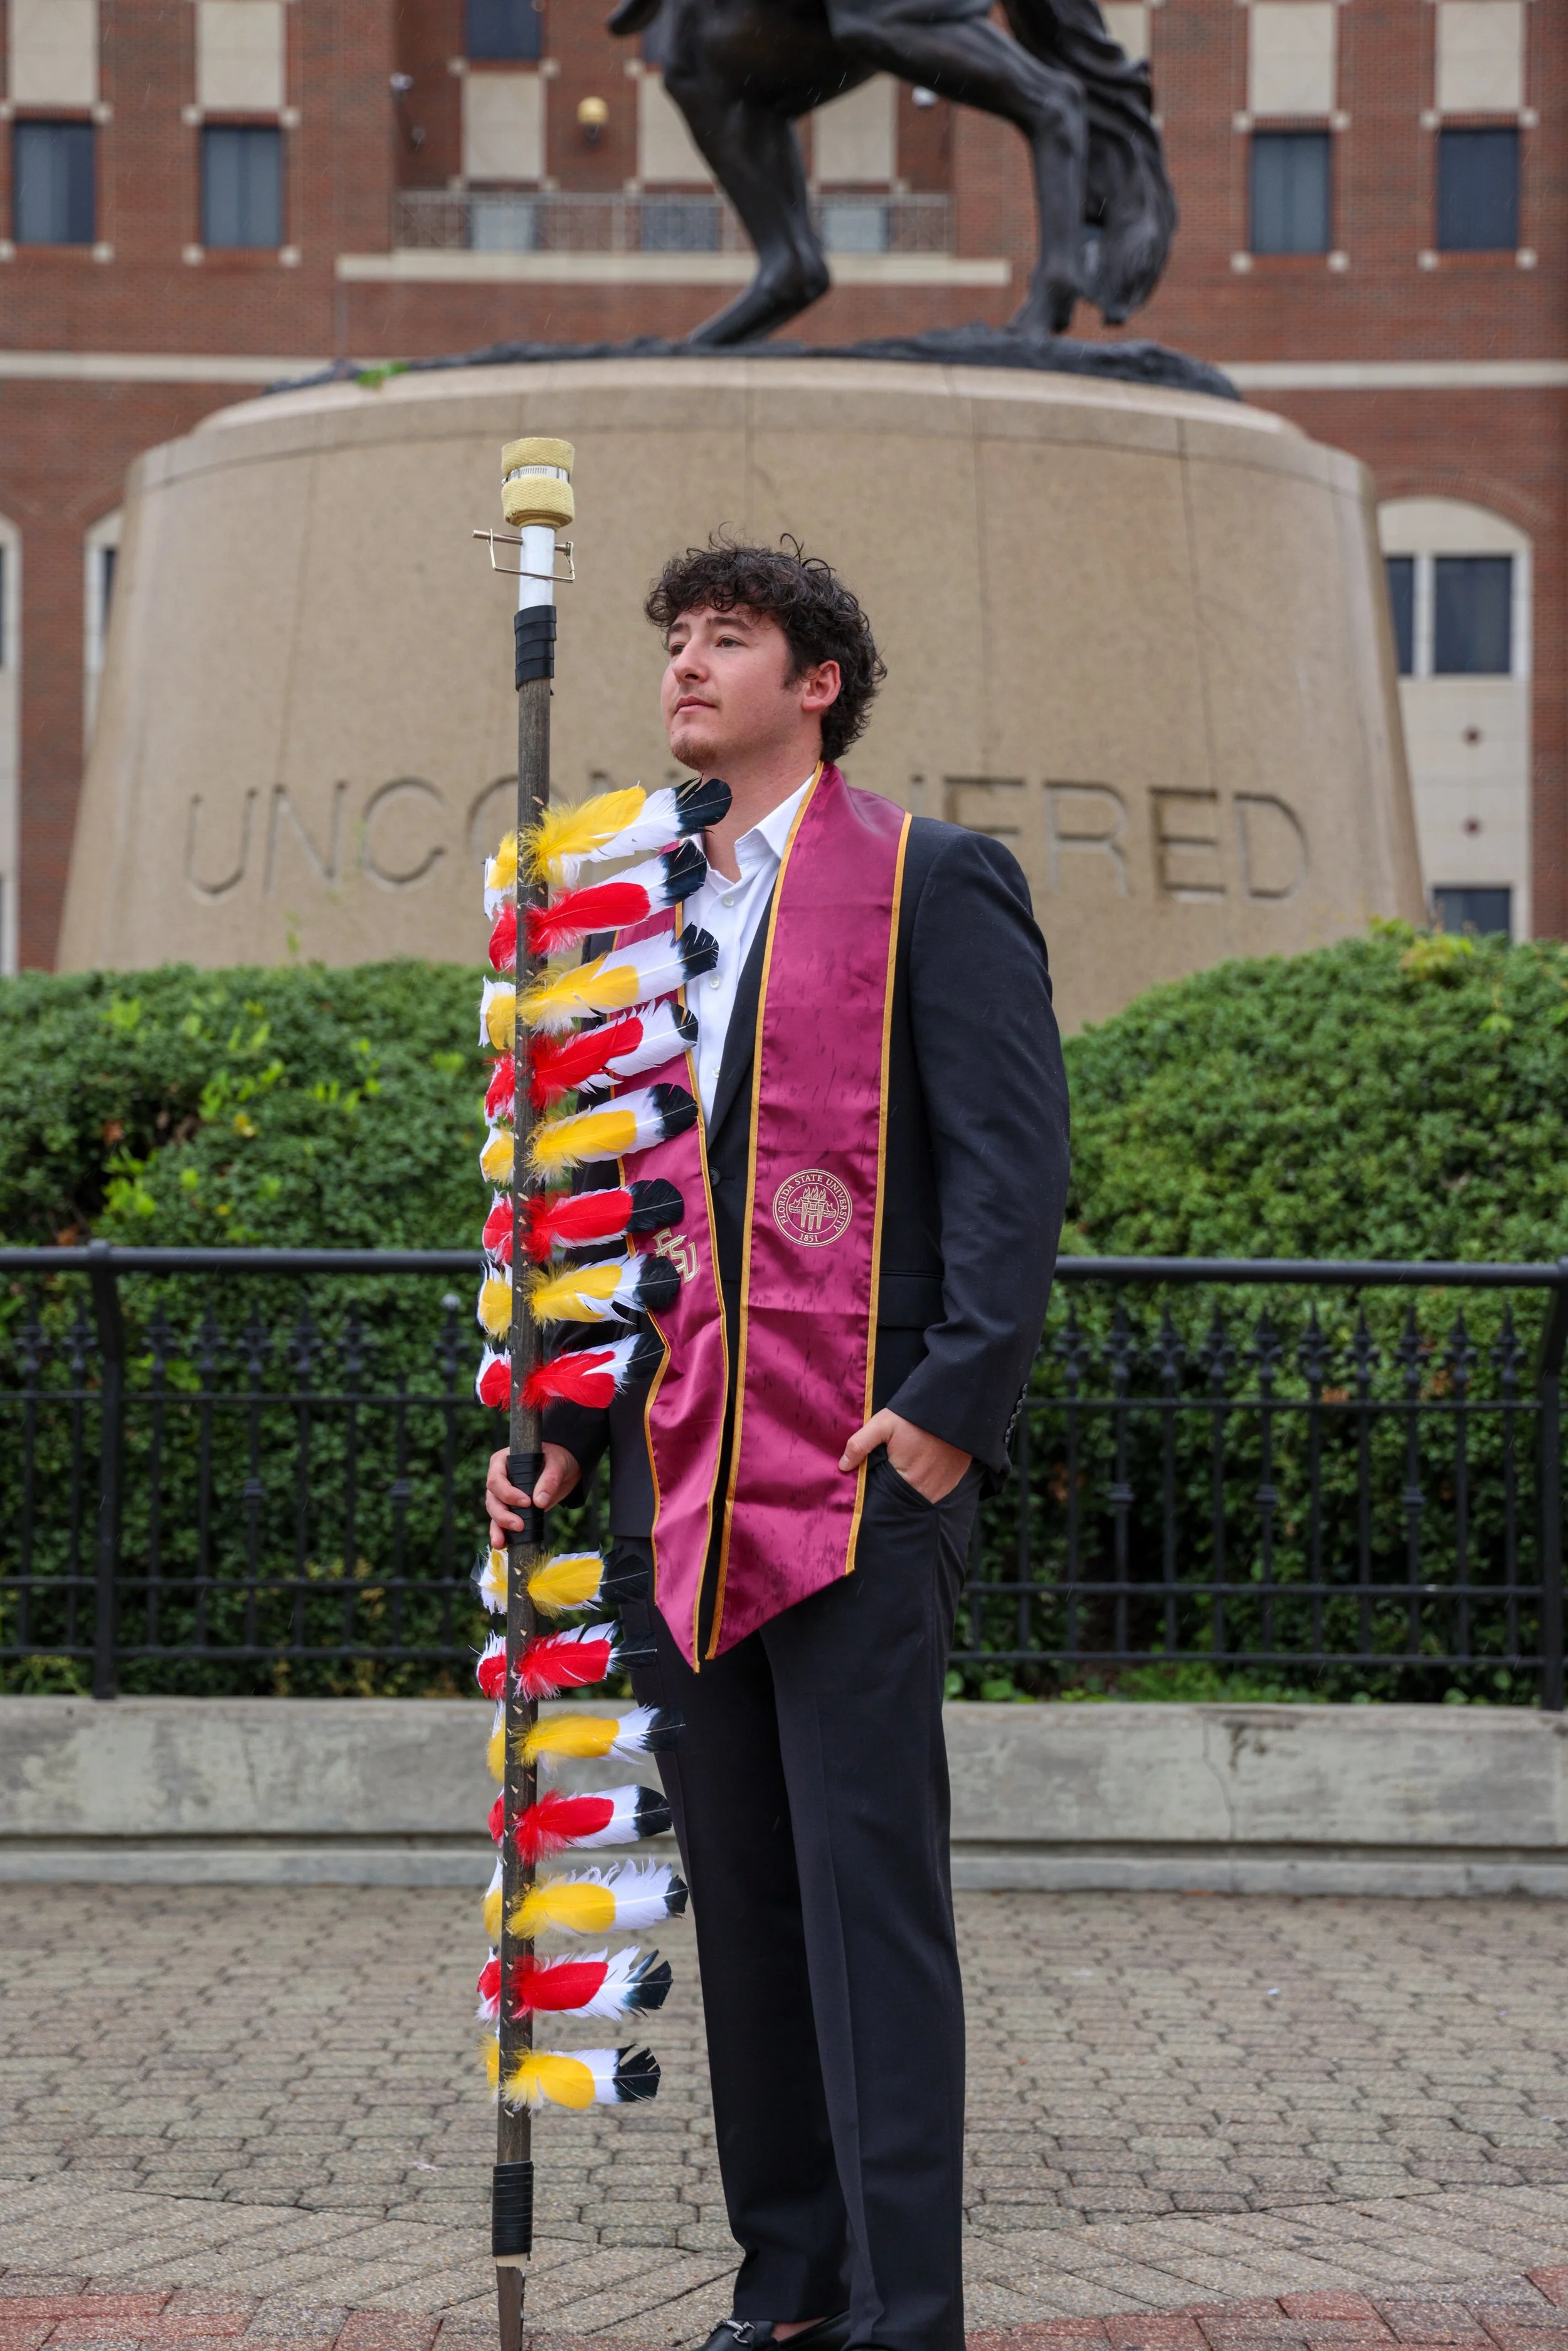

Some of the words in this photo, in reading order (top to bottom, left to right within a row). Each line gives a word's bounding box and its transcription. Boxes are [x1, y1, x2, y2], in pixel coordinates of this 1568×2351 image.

[778, 1184, 794, 1224] FLORIDA
[795, 1174, 823, 1185] STATE
[825, 1178, 847, 1231] UNIVERSITY
[652, 1228, 697, 1283] FSU
[799, 1233, 819, 1242] 1851
